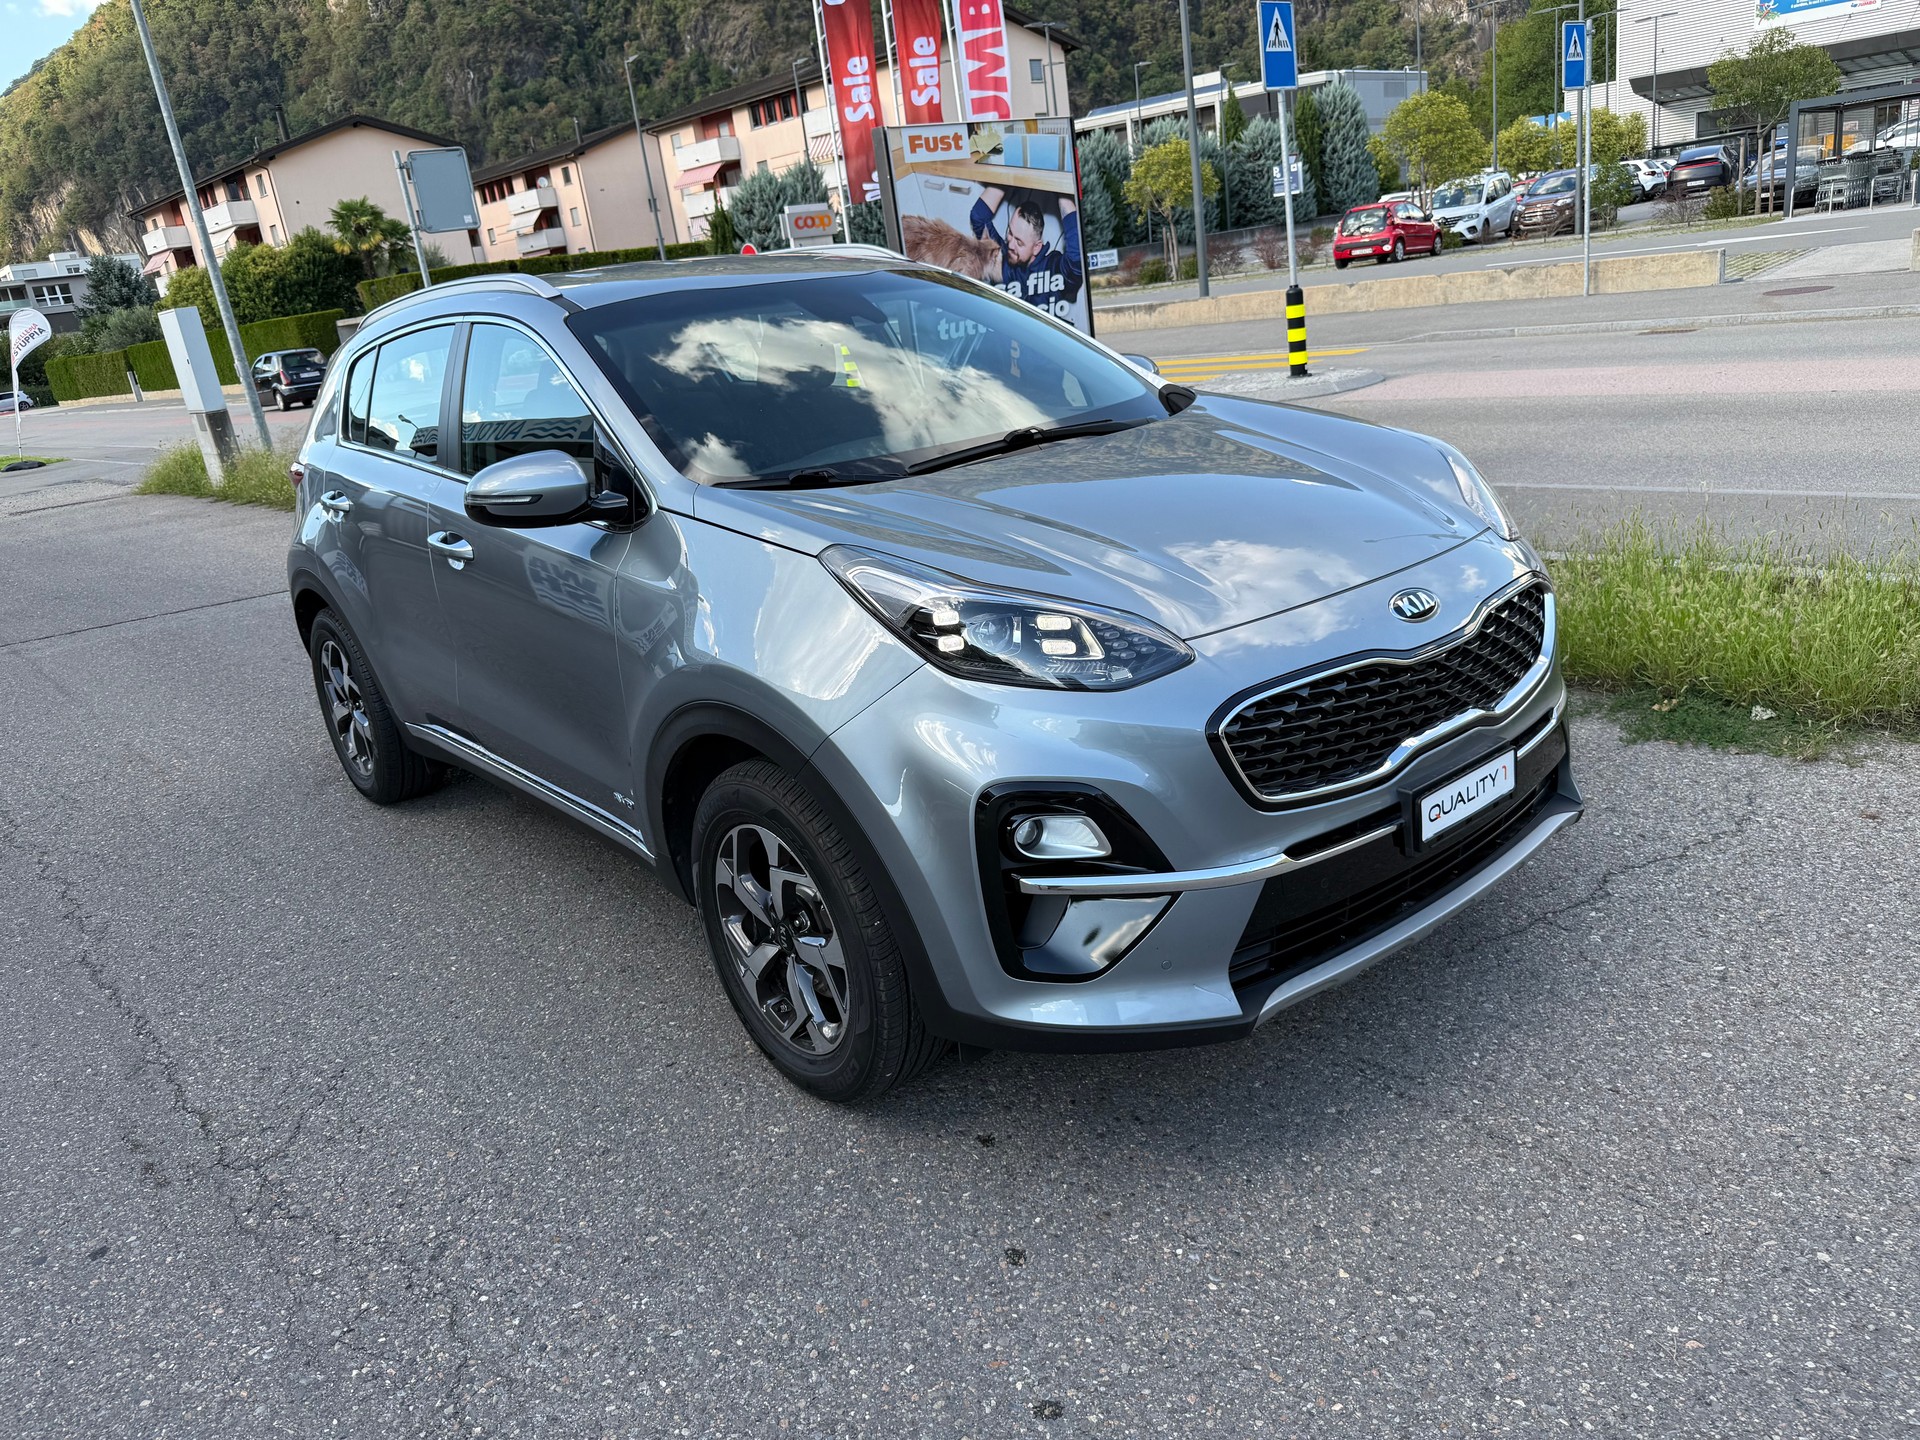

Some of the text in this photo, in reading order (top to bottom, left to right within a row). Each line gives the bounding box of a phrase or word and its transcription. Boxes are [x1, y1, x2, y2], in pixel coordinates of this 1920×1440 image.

[908, 36, 940, 107] Sale
[843, 55, 875, 122] Sale
[908, 132, 963, 154] Fust
[794, 213, 833, 231] coop
[1026, 270, 1065, 296] fila
[13, 327, 46, 357] STUPPIA
[1396, 590, 1436, 617] KIA
[1428, 768, 1499, 823] QUALITY
